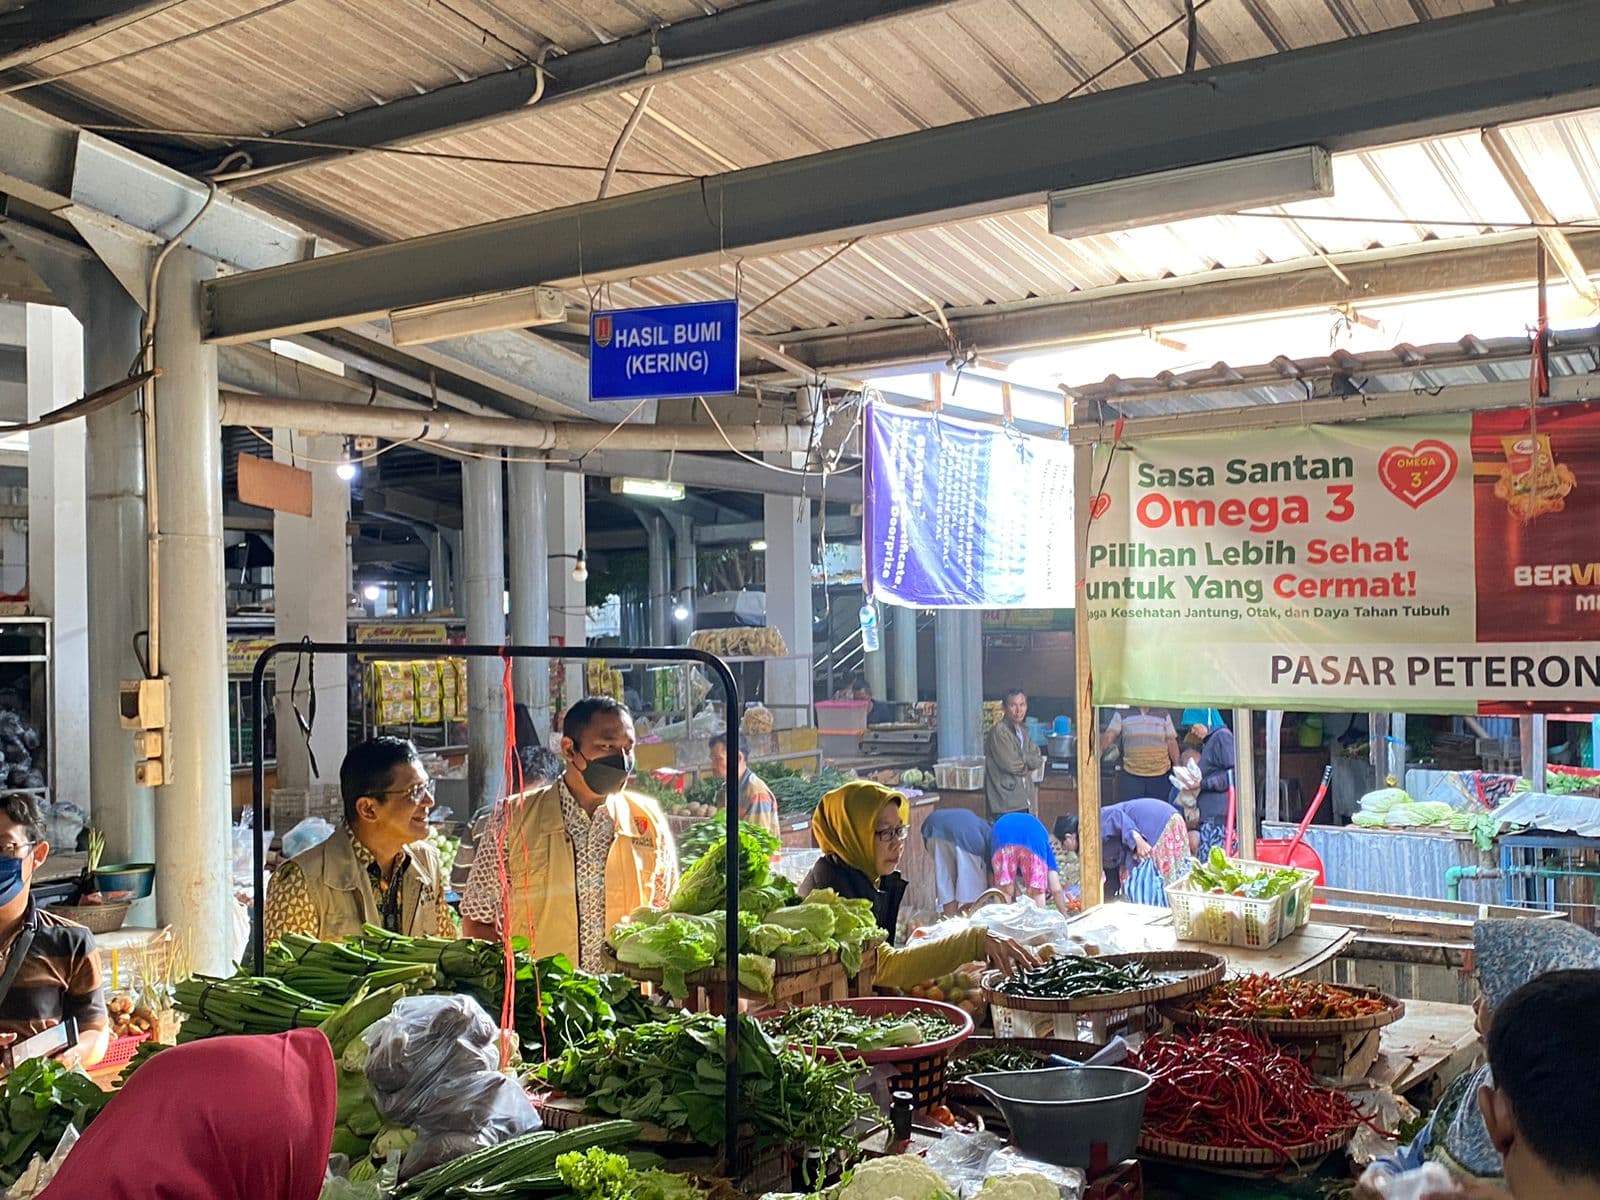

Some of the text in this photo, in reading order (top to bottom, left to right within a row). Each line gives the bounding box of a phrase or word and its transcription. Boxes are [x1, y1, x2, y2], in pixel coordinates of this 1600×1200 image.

[615, 321, 721, 348] HASIL BUMI
[626, 350, 708, 379] (KERING)
[1138, 453, 1354, 488] Sasa Santan
[1397, 457, 1436, 468] OMEGA
[1411, 472, 1422, 488] 3
[1136, 484, 1355, 534] Omega 3
[882, 506, 900, 578] Doorprize
[1090, 536, 1409, 568] Pilihan Lebih Sehat
[1086, 570, 1417, 603] untuk Yang Cermat!
[1111, 607, 1181, 618] Kesehatan
[1184, 607, 1242, 619] Jantung,
[1246, 606, 1281, 619] Otak,
[1284, 607, 1310, 618] dan
[1313, 607, 1350, 619] Daya
[1353, 606, 1398, 617] Tahan
[1402, 604, 1450, 617] Tubuh
[1271, 655, 1600, 688] PASAR PETERON
